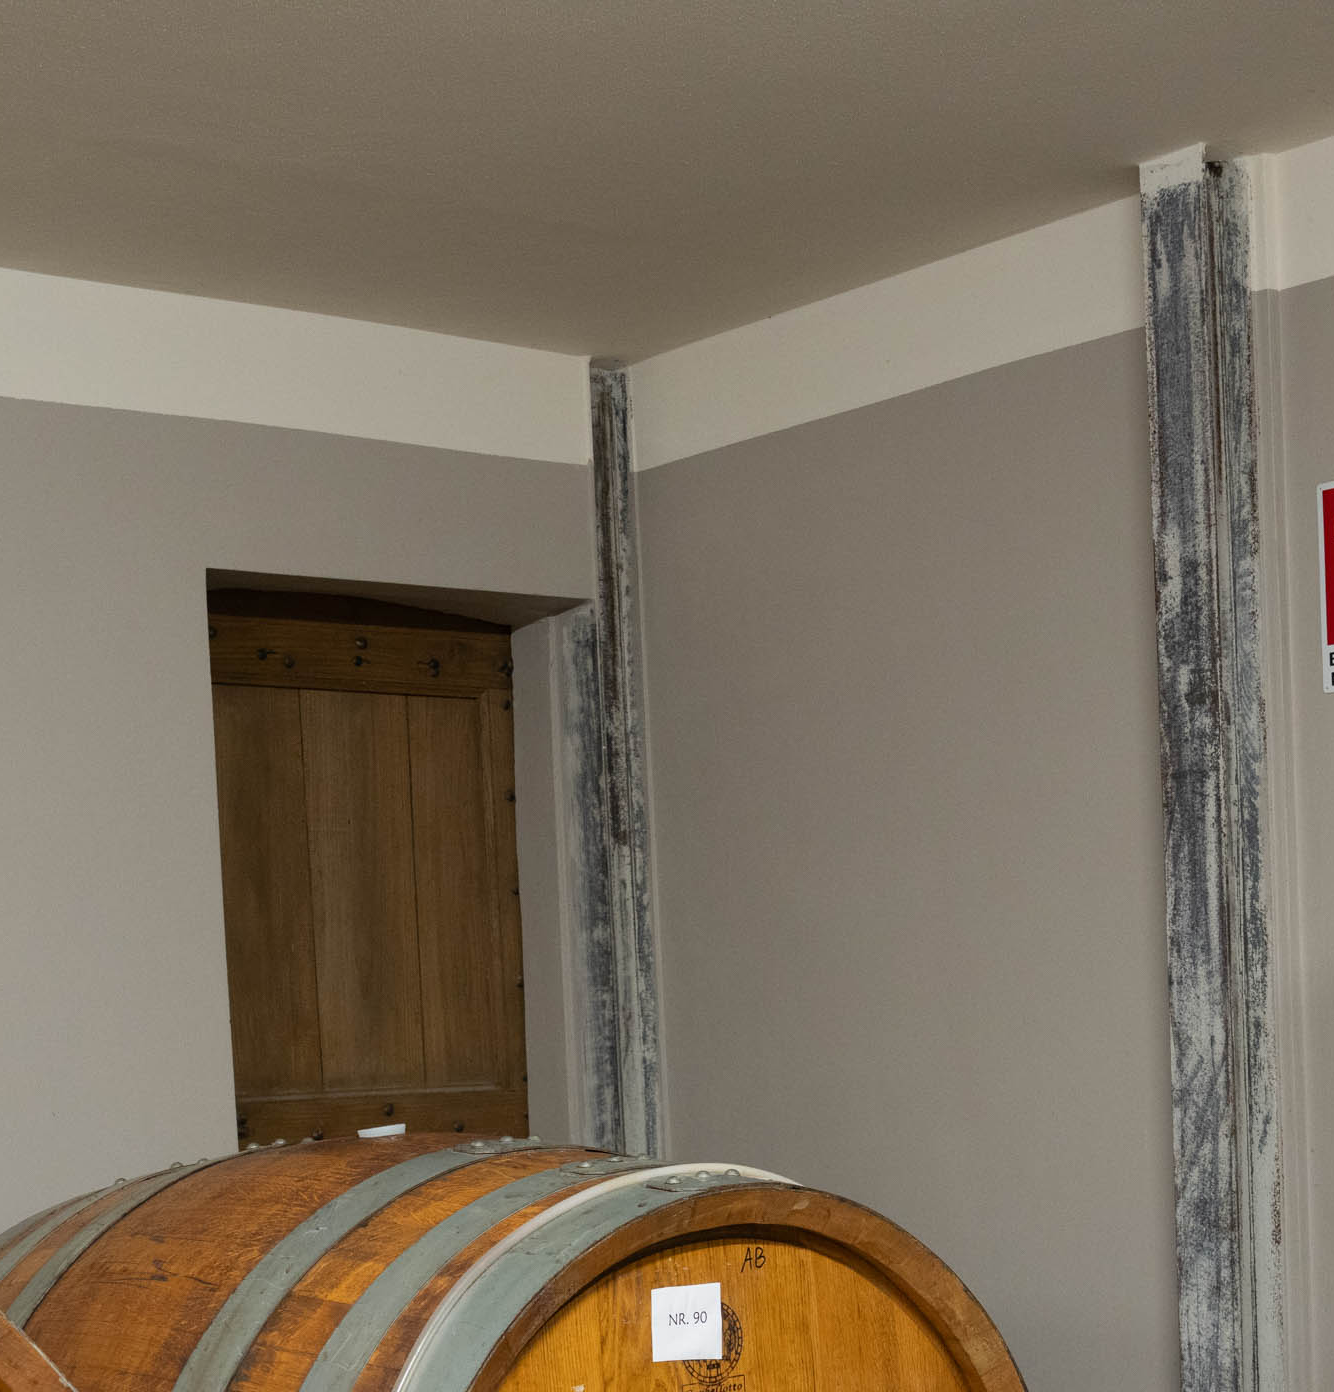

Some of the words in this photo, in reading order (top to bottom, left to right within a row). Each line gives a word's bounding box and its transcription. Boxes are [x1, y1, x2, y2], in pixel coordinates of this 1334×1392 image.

[741, 1247, 766, 1273] AB
[668, 1313, 690, 1327] NR.
[693, 1311, 708, 1325] 90
